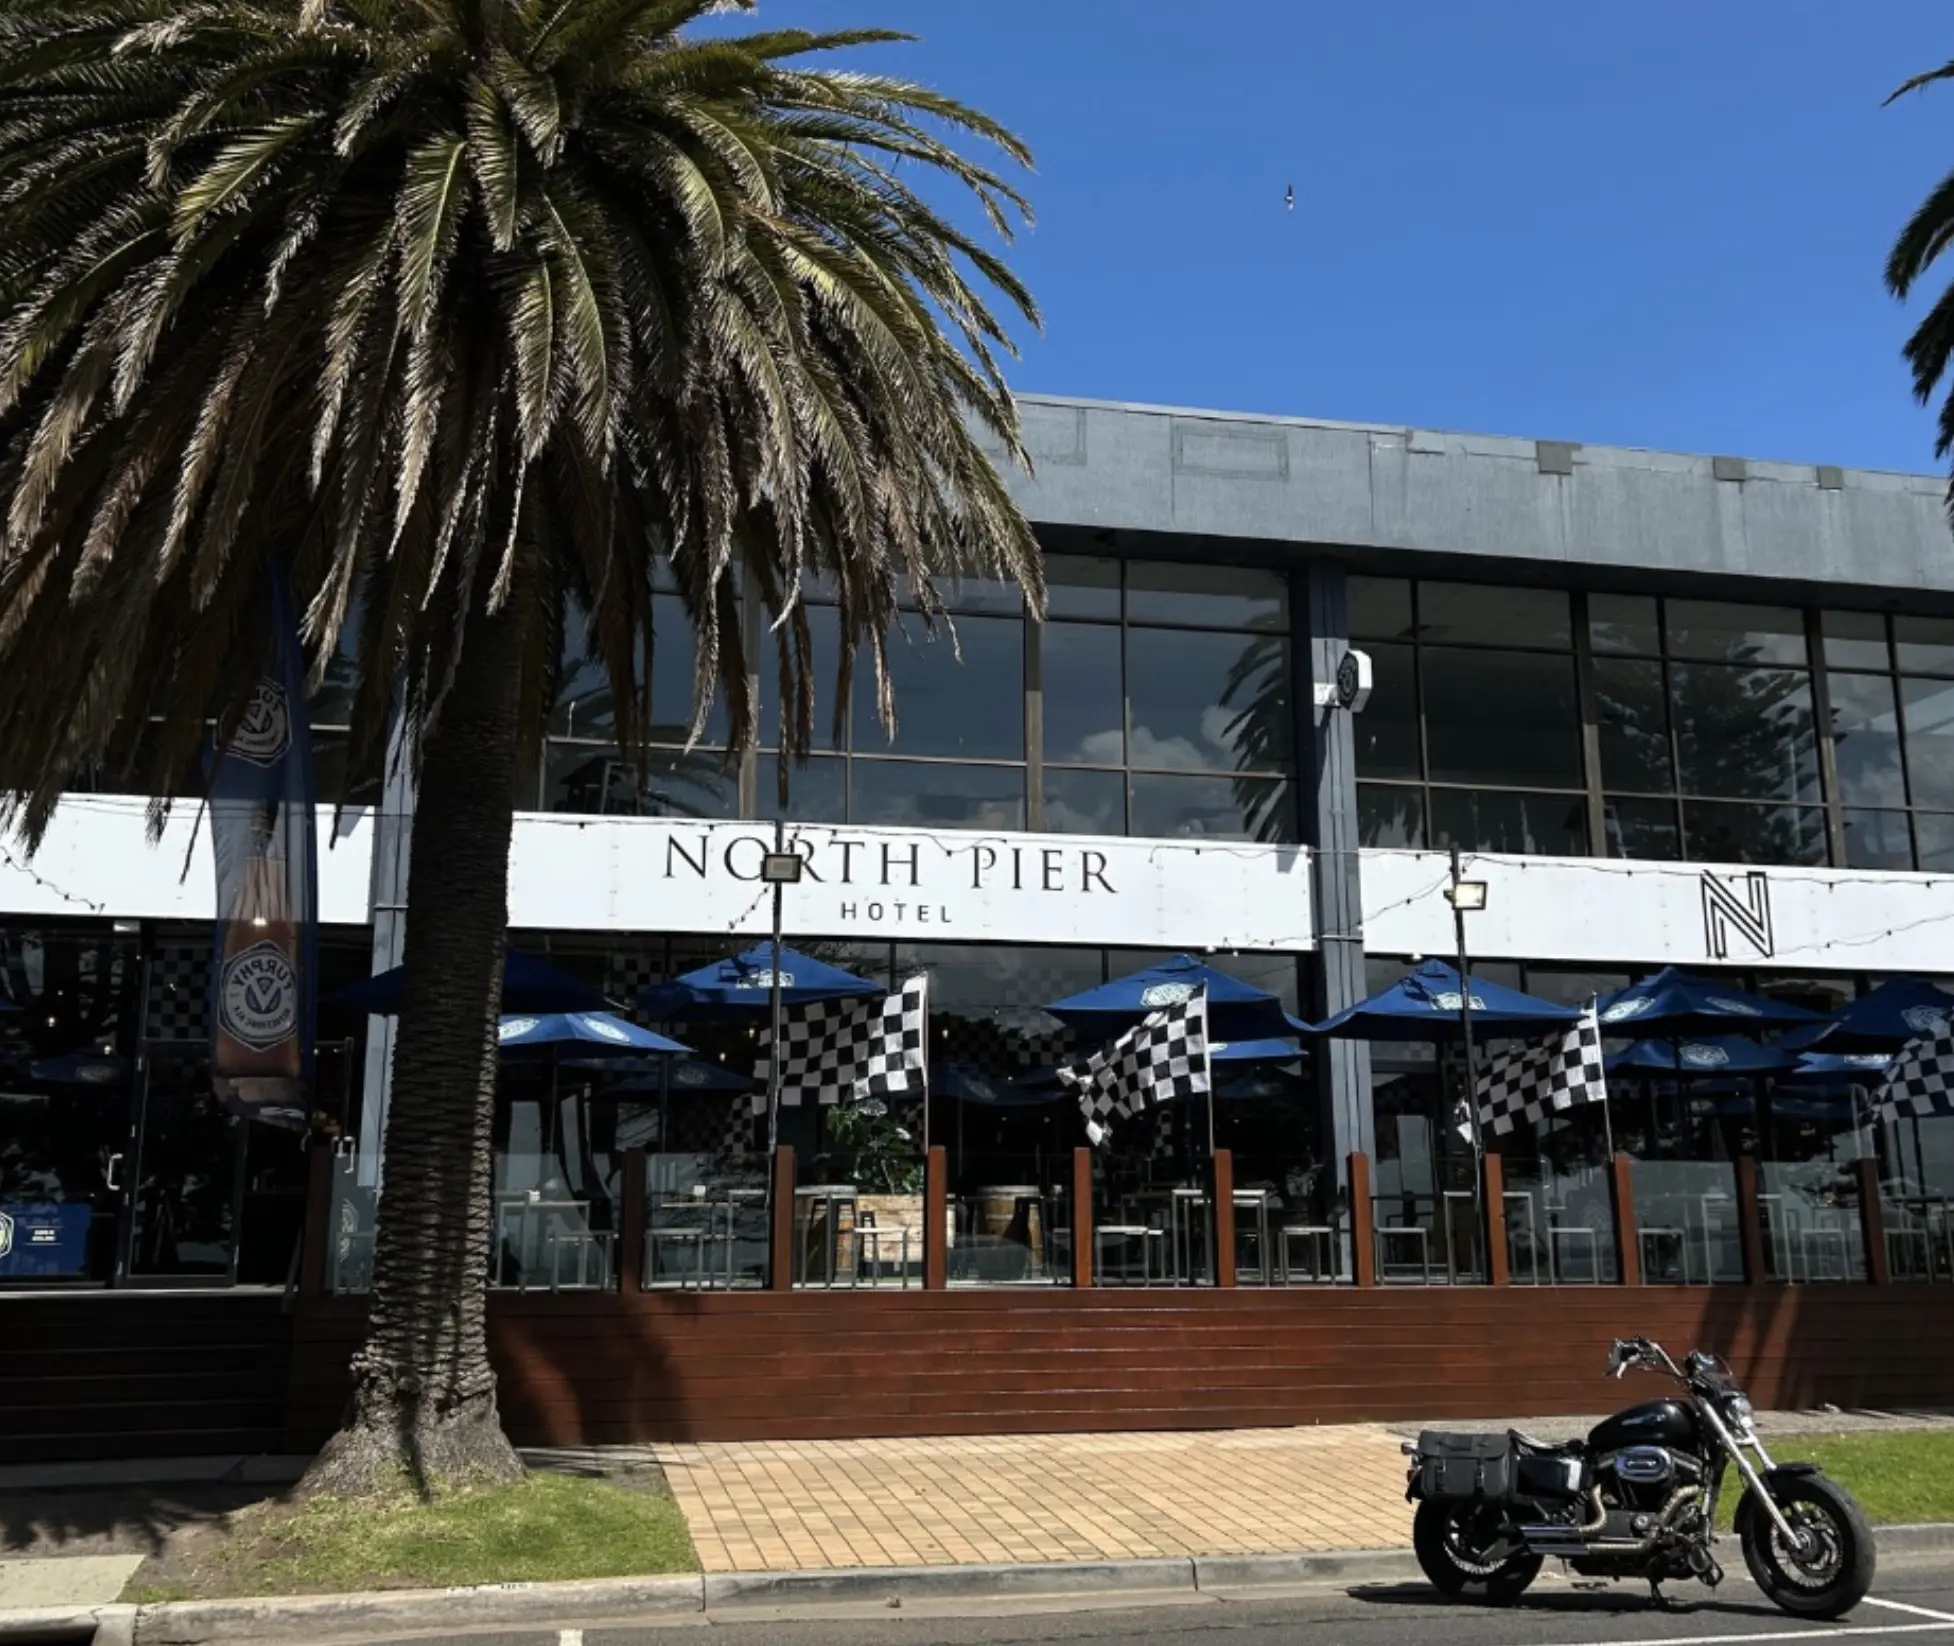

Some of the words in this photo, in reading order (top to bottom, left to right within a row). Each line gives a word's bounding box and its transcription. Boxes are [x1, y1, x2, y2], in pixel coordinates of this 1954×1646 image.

[663, 834, 920, 886] NORTH
[970, 845, 1119, 894] PIER
[841, 901, 952, 923] HOTEL
[1700, 868, 1775, 960] N
